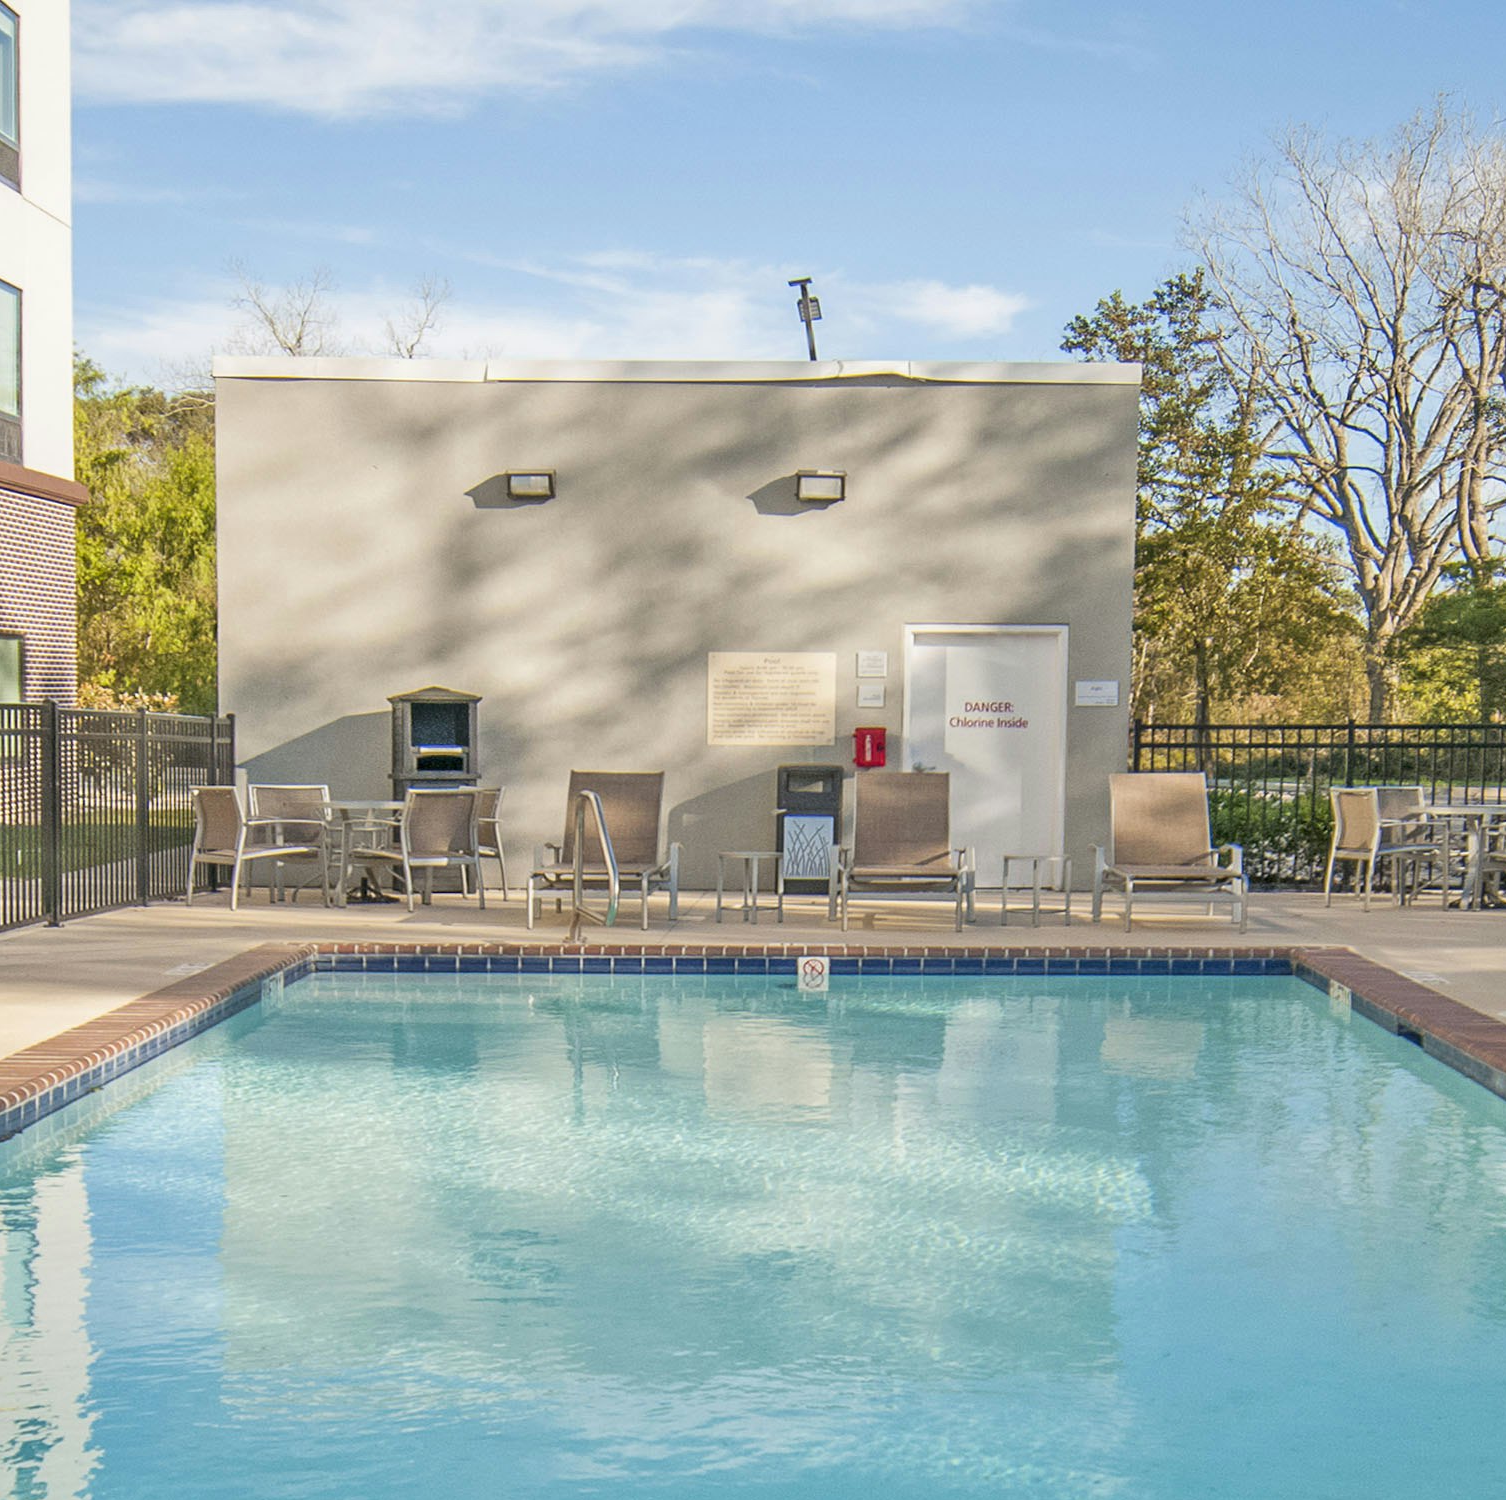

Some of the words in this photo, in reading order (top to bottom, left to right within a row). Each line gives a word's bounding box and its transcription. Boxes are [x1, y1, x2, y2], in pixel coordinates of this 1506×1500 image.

[964, 701, 1015, 713] DANGER:
[949, 716, 995, 729] Chlorine
[997, 716, 1029, 729] Inside
